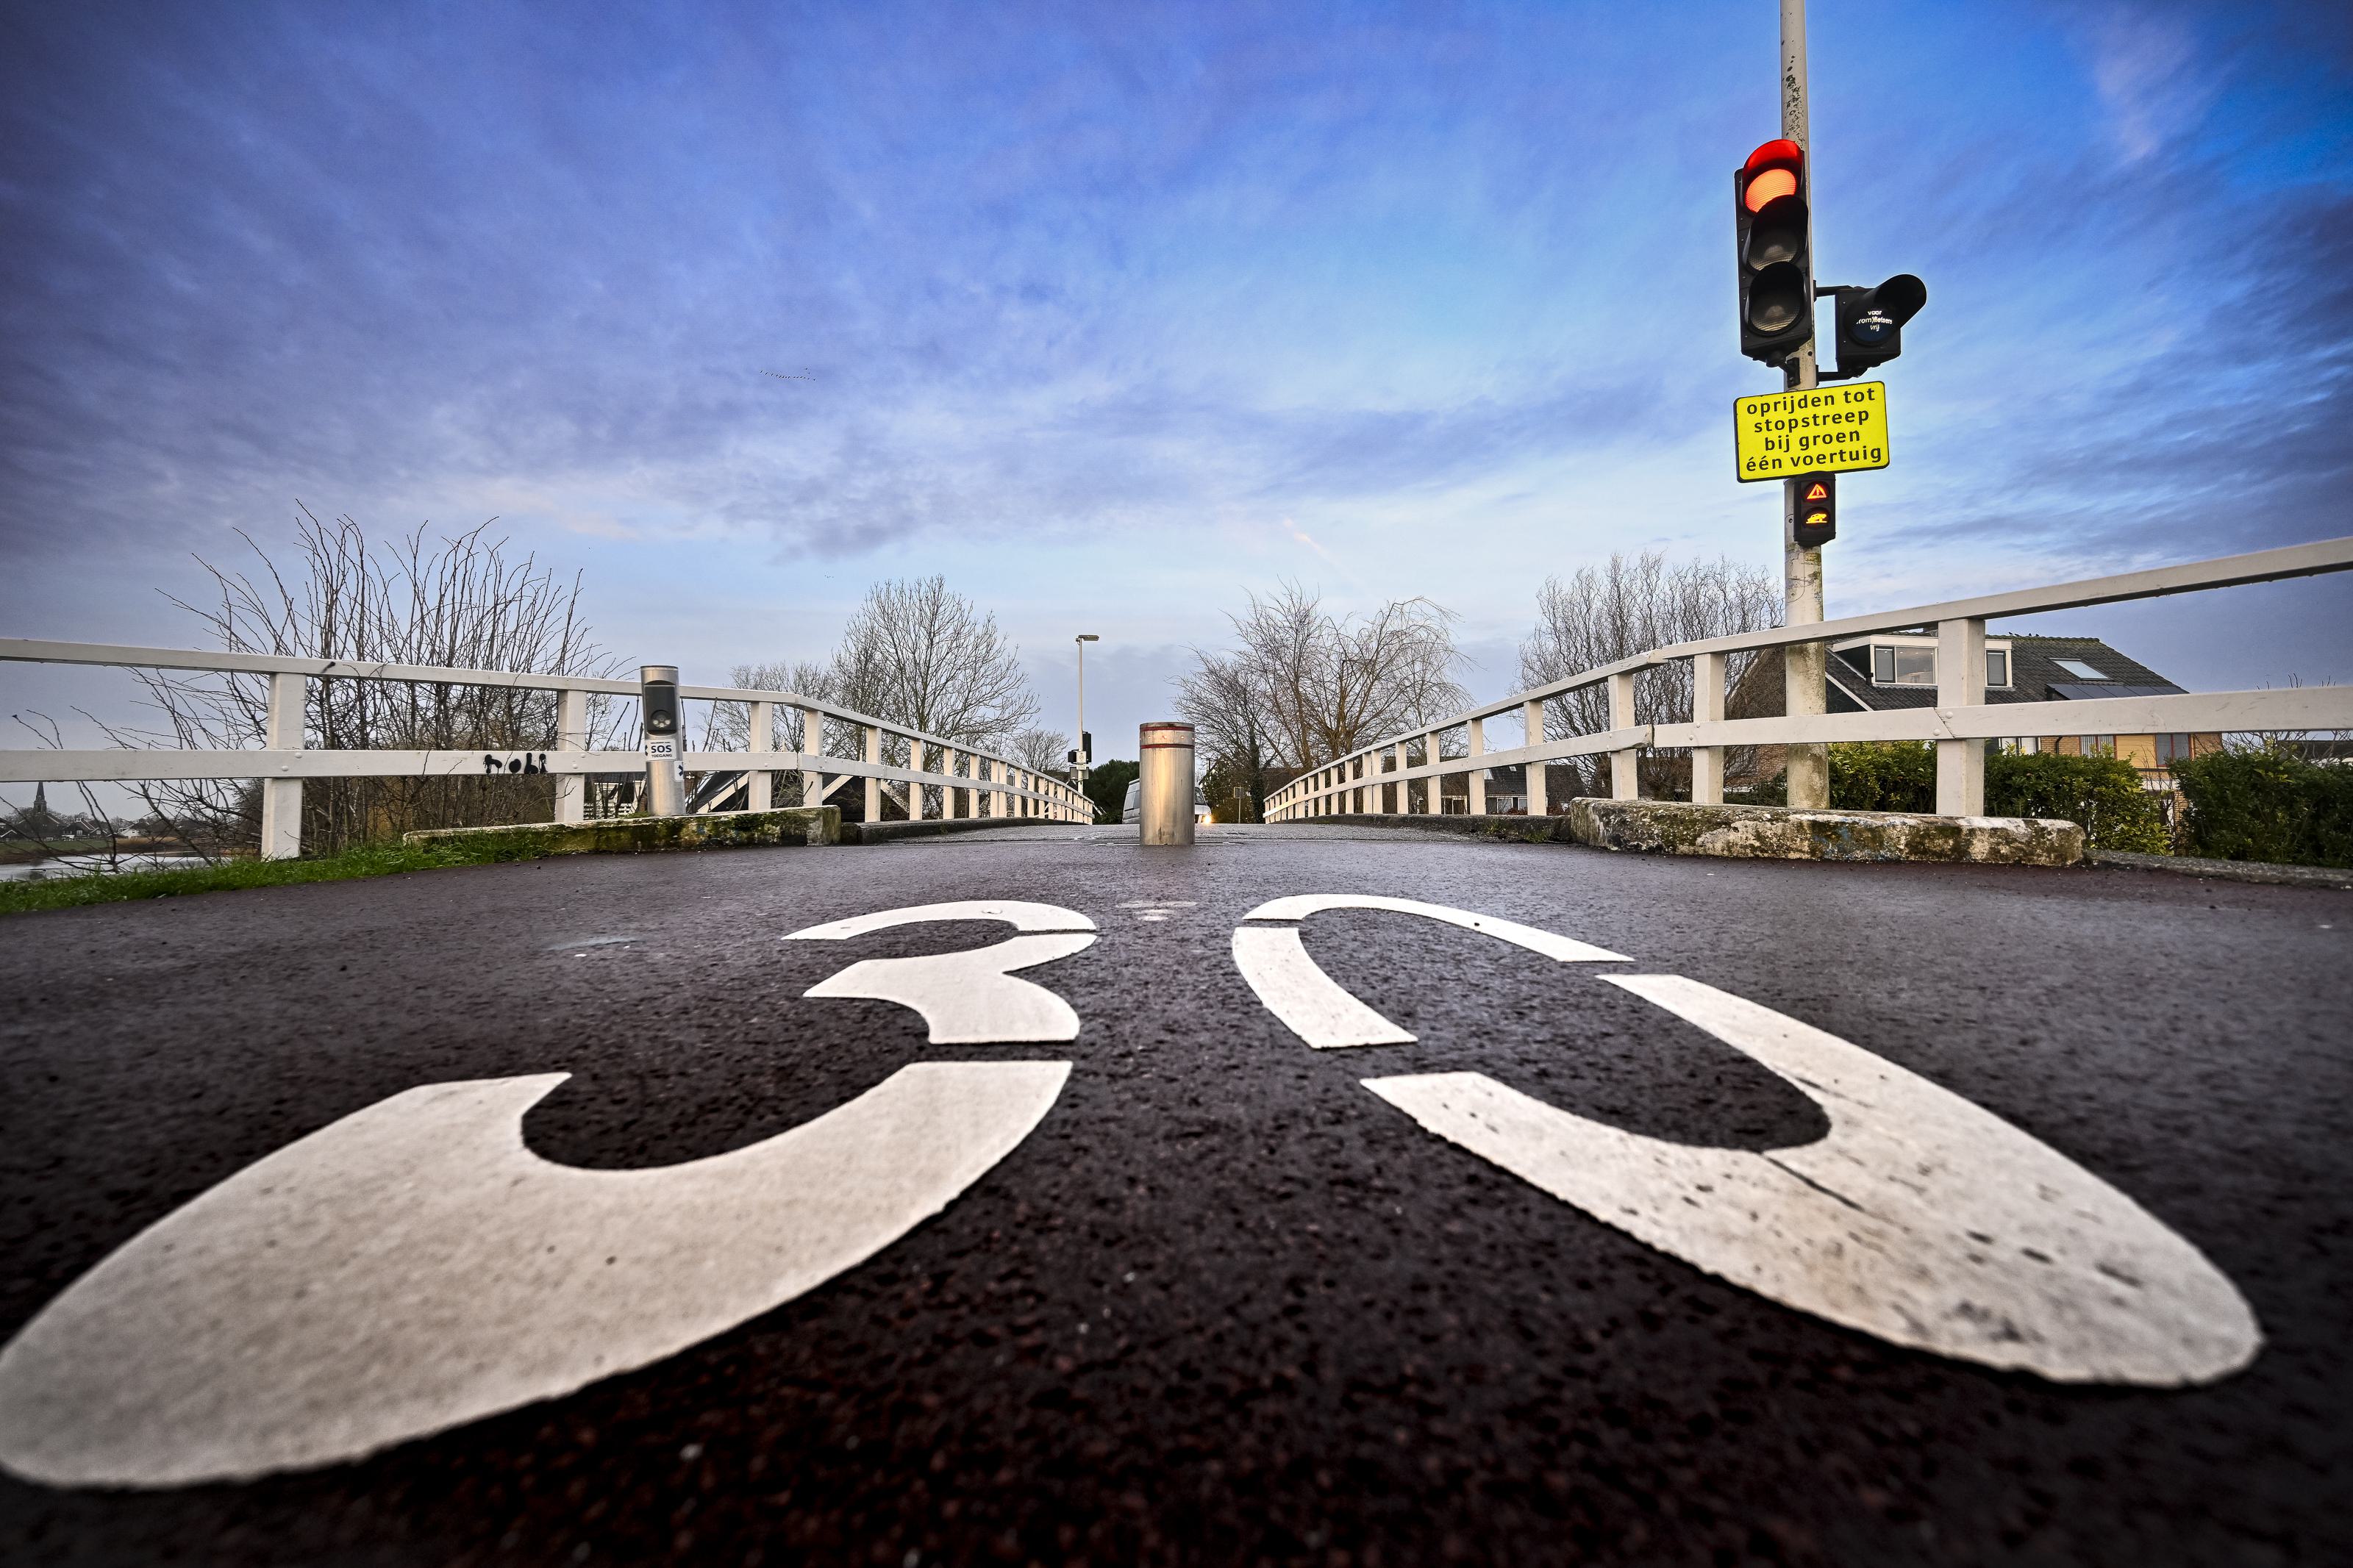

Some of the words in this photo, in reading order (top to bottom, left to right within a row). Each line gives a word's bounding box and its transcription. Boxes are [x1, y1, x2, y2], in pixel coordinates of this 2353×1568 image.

[1746, 394, 1835, 417] oprijden
[1843, 388, 1875, 404] tot
[1754, 409, 1869, 433] stopstreep
[1765, 434, 1790, 453] bij
[1799, 430, 1860, 451] groen
[1746, 456, 1782, 472] één
[1790, 445, 1881, 467] voertuig
[651, 745, 672, 753] SOS
[0, 893, 2265, 1490] 30
